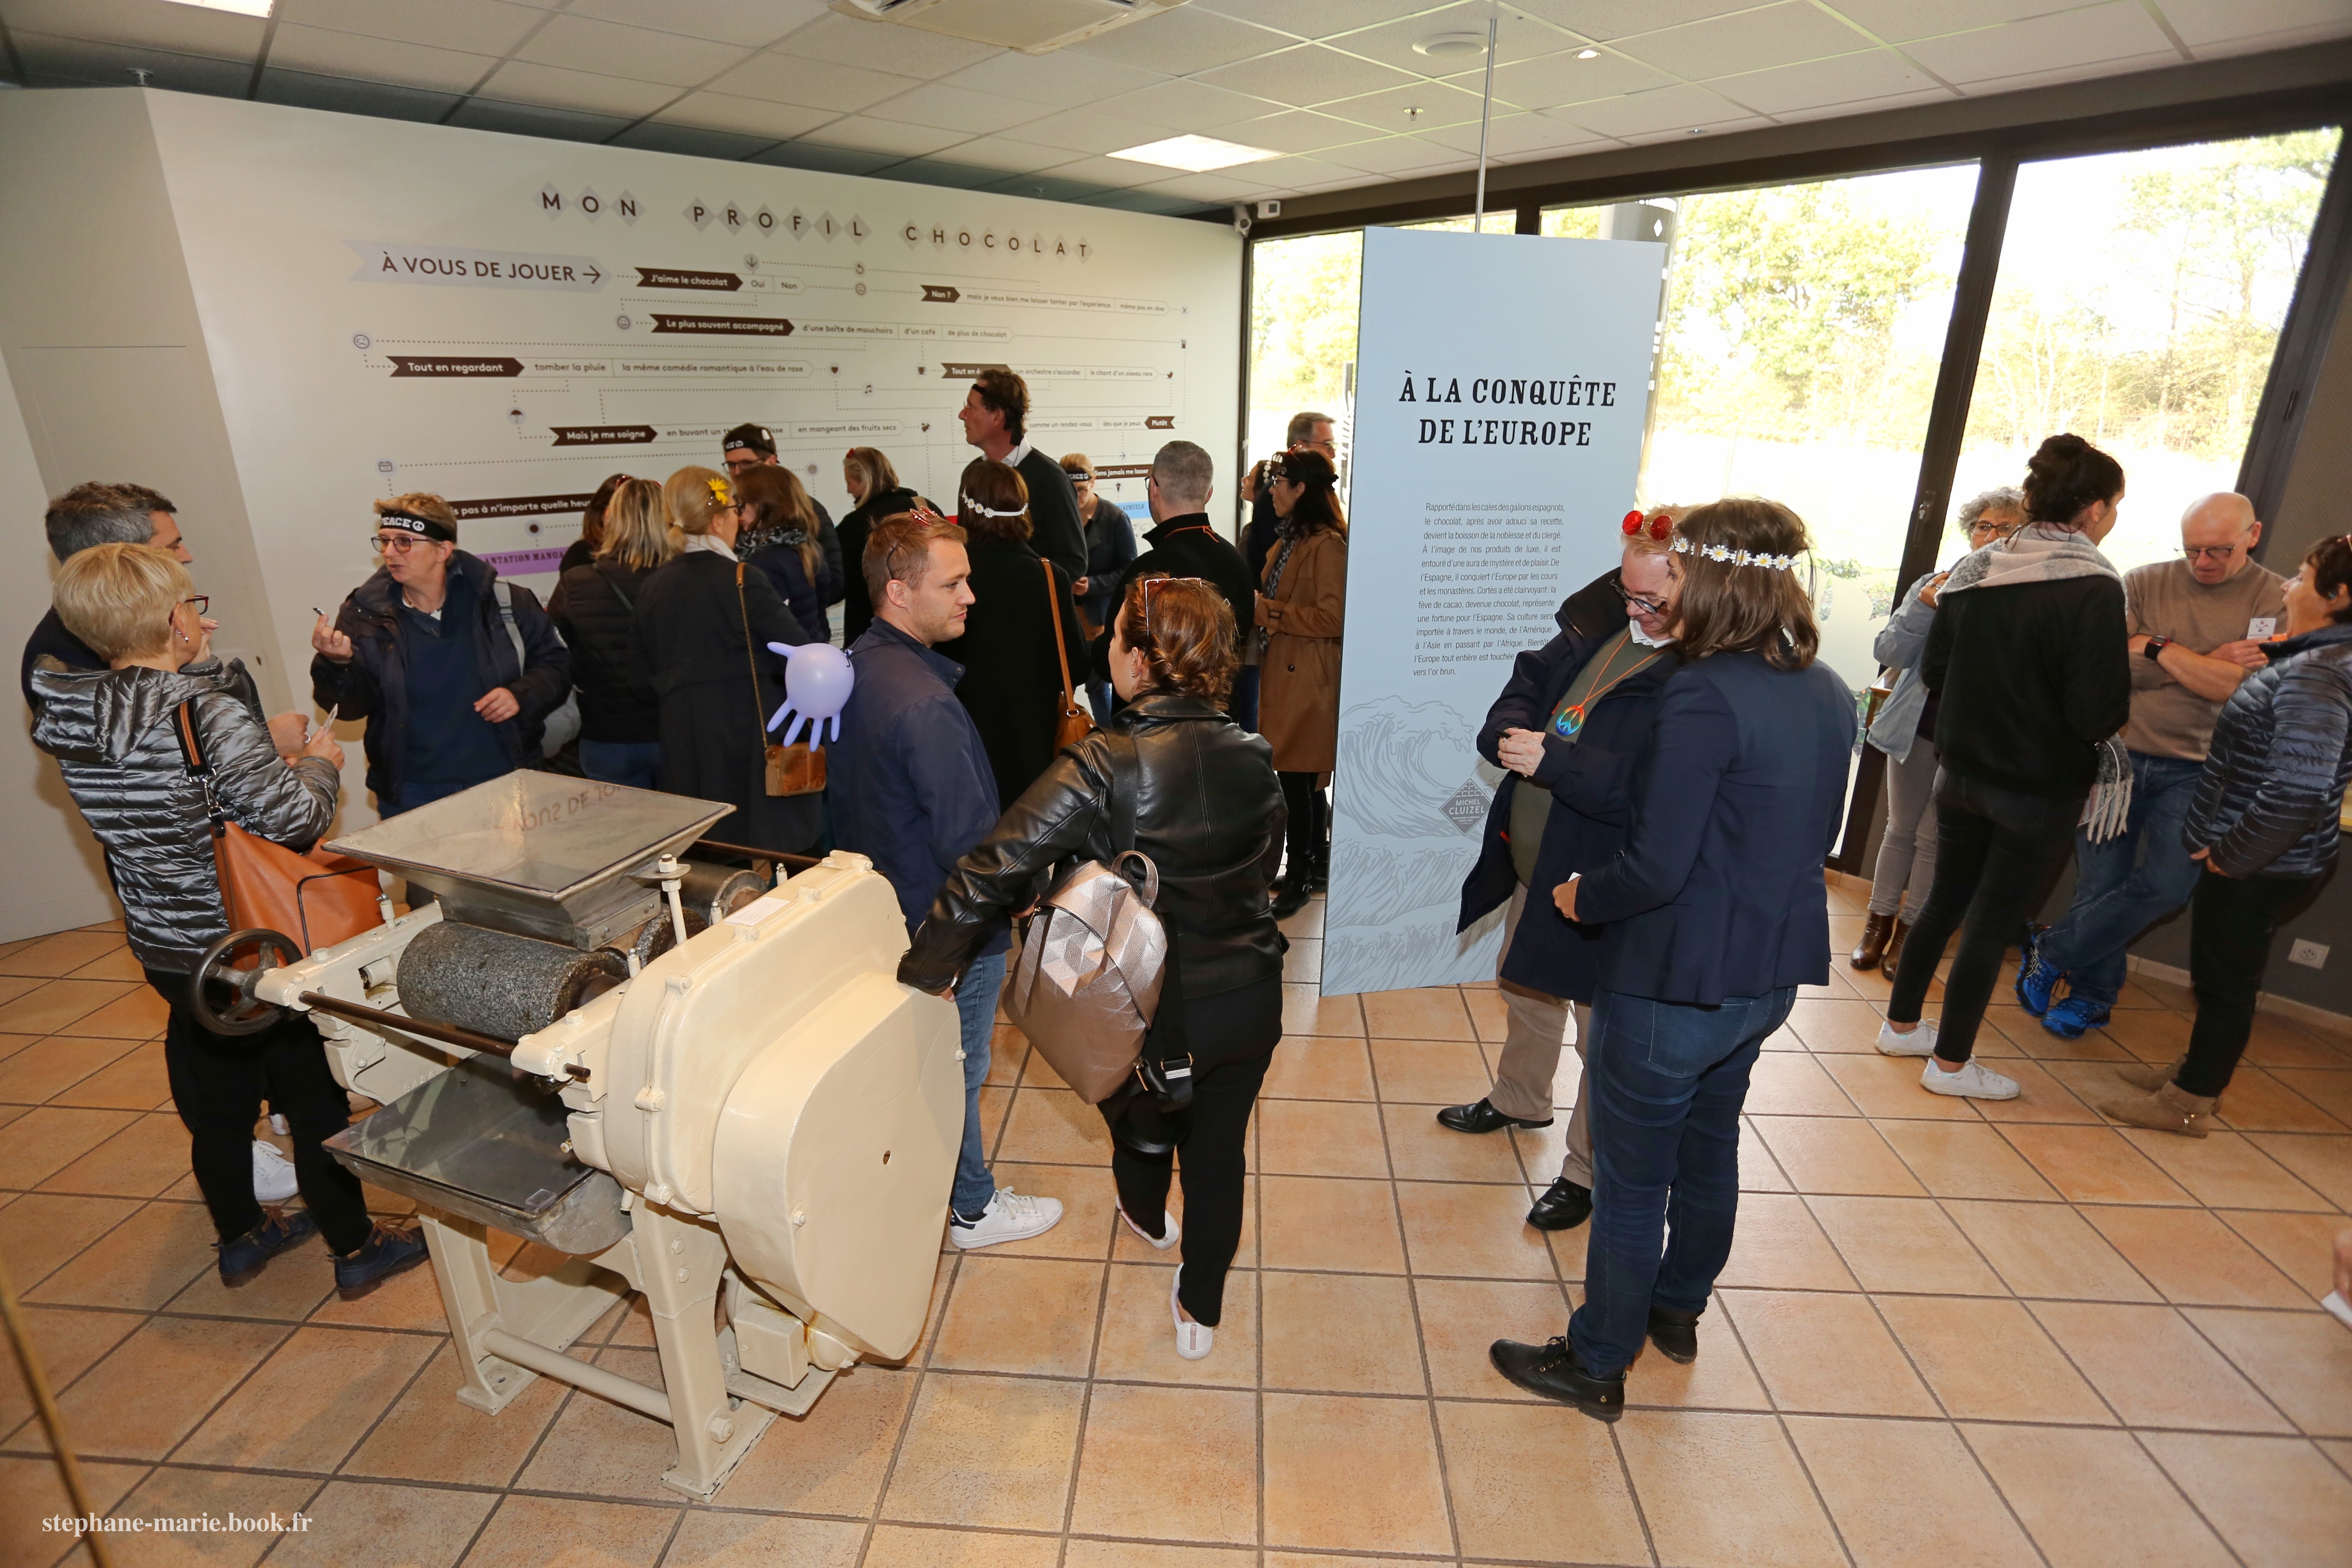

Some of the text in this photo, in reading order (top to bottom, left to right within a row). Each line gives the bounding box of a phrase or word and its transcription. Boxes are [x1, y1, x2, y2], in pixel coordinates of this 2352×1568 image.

[542, 192, 1086, 257] MON PROFIL CHOCOLAT
[382, 251, 576, 282] À VOUS DE JOUER
[651, 274, 728, 286] J'aime le chocolat
[750, 279, 765, 288] Oui
[666, 319, 677, 328] Le
[678, 320, 696, 329] plus
[732, 323, 784, 332] accompagné
[407, 362, 433, 372] Tout
[451, 363, 503, 374] regardant
[584, 363, 606, 373] pluie
[700, 364, 747, 373] romantique
[1399, 370, 1616, 407] À LA CONQUÊTE
[567, 431, 588, 440] Mais
[591, 431, 599, 441] je
[617, 430, 646, 440] soigne
[1418, 419, 1591, 446] DE L'EUROPE
[1107, 469, 1125, 477] jamais
[461, 501, 569, 517] pas à n'importe quelle
[1426, 502, 1565, 513] Rapporté dans les cales des galions espagnols,
[1424, 517, 1431, 525] le
[1434, 517, 1463, 526] chocolat,
[1466, 517, 1484, 527] après
[1487, 517, 1503, 525] avoir
[1506, 517, 1527, 525] adouci
[1540, 518, 1563, 526] recette,
[1424, 531, 1447, 539] devient
[1448, 531, 1454, 539] la
[1455, 531, 1479, 539] boisson
[1496, 531, 1524, 539] noblesse
[1541, 531, 1562, 541] clergé.
[1422, 544, 1427, 554] À
[1431, 545, 1455, 555] l'image
[1485, 545, 1511, 554] produits
[1526, 545, 1540, 554] luxe,
[485, 551, 564, 564] ANTATION MANGA
[1421, 559, 1446, 567] entouré
[1447, 559, 1465, 567] d'une
[1489, 558, 1515, 568] mystère
[1530, 558, 1550, 568] plaisir.
[1421, 573, 1453, 583] l'Espagne,
[1460, 573, 1490, 582] conquiert
[1491, 572, 1517, 582] l'Europe
[1437, 586, 1476, 595] monastères.
[1477, 586, 1498, 594] Cortès
[1493, 600, 1521, 608] chocolat,
[1522, 599, 1555, 608] représente
[1432, 614, 1454, 622] fortune
[1456, 615, 1471, 623] pour
[1473, 613, 1504, 622] l'Espagne.
[1507, 612, 1515, 621] Sa
[1416, 628, 1444, 637] importée
[1446, 627, 1451, 635] à
[1519, 625, 1552, 634] l'Amérique
[1455, 641, 1480, 649] passant
[1497, 640, 1524, 648] l'Afrique.
[1414, 655, 1440, 664] l'Europe
[1456, 653, 1477, 662] entière
[1449, 805, 1485, 815] CLUIZEL
